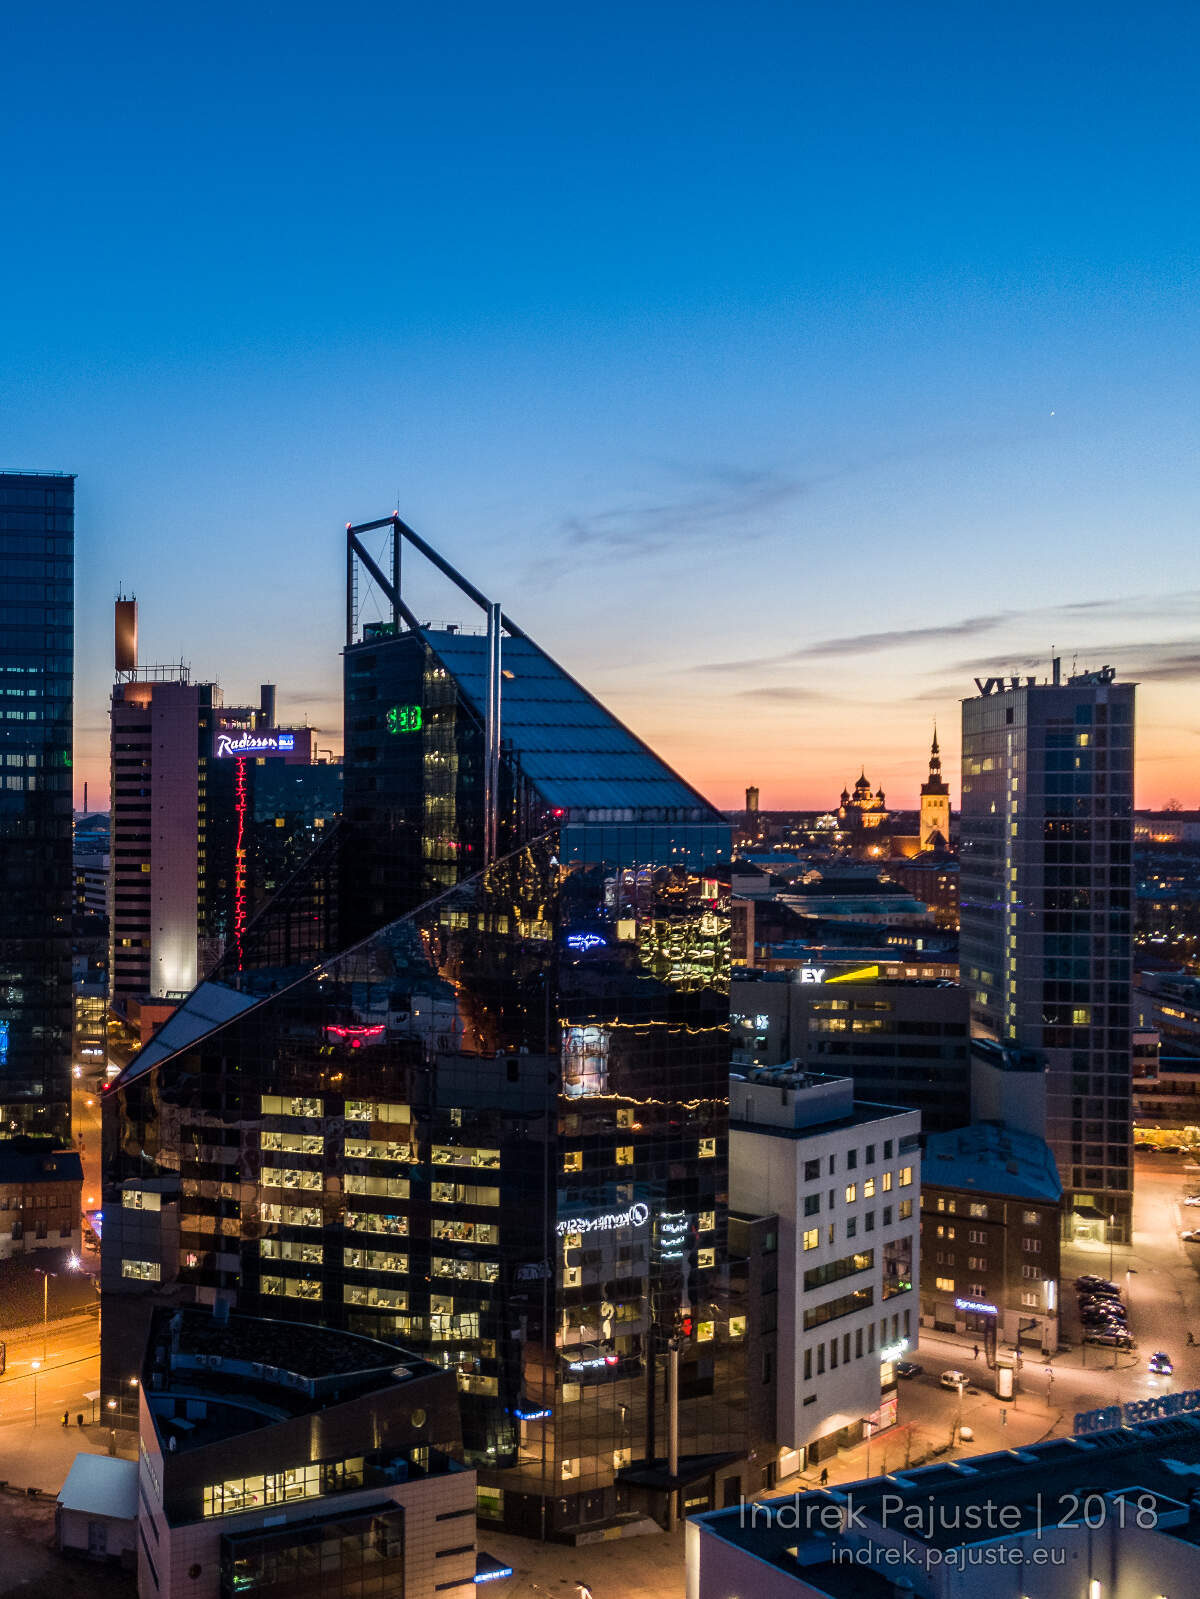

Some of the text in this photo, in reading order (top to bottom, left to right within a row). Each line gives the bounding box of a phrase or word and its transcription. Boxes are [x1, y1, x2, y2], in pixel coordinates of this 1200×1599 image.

[386, 706, 422, 733] SEB
[217, 732, 278, 757] Radisson
[801, 968, 825, 983] EY
